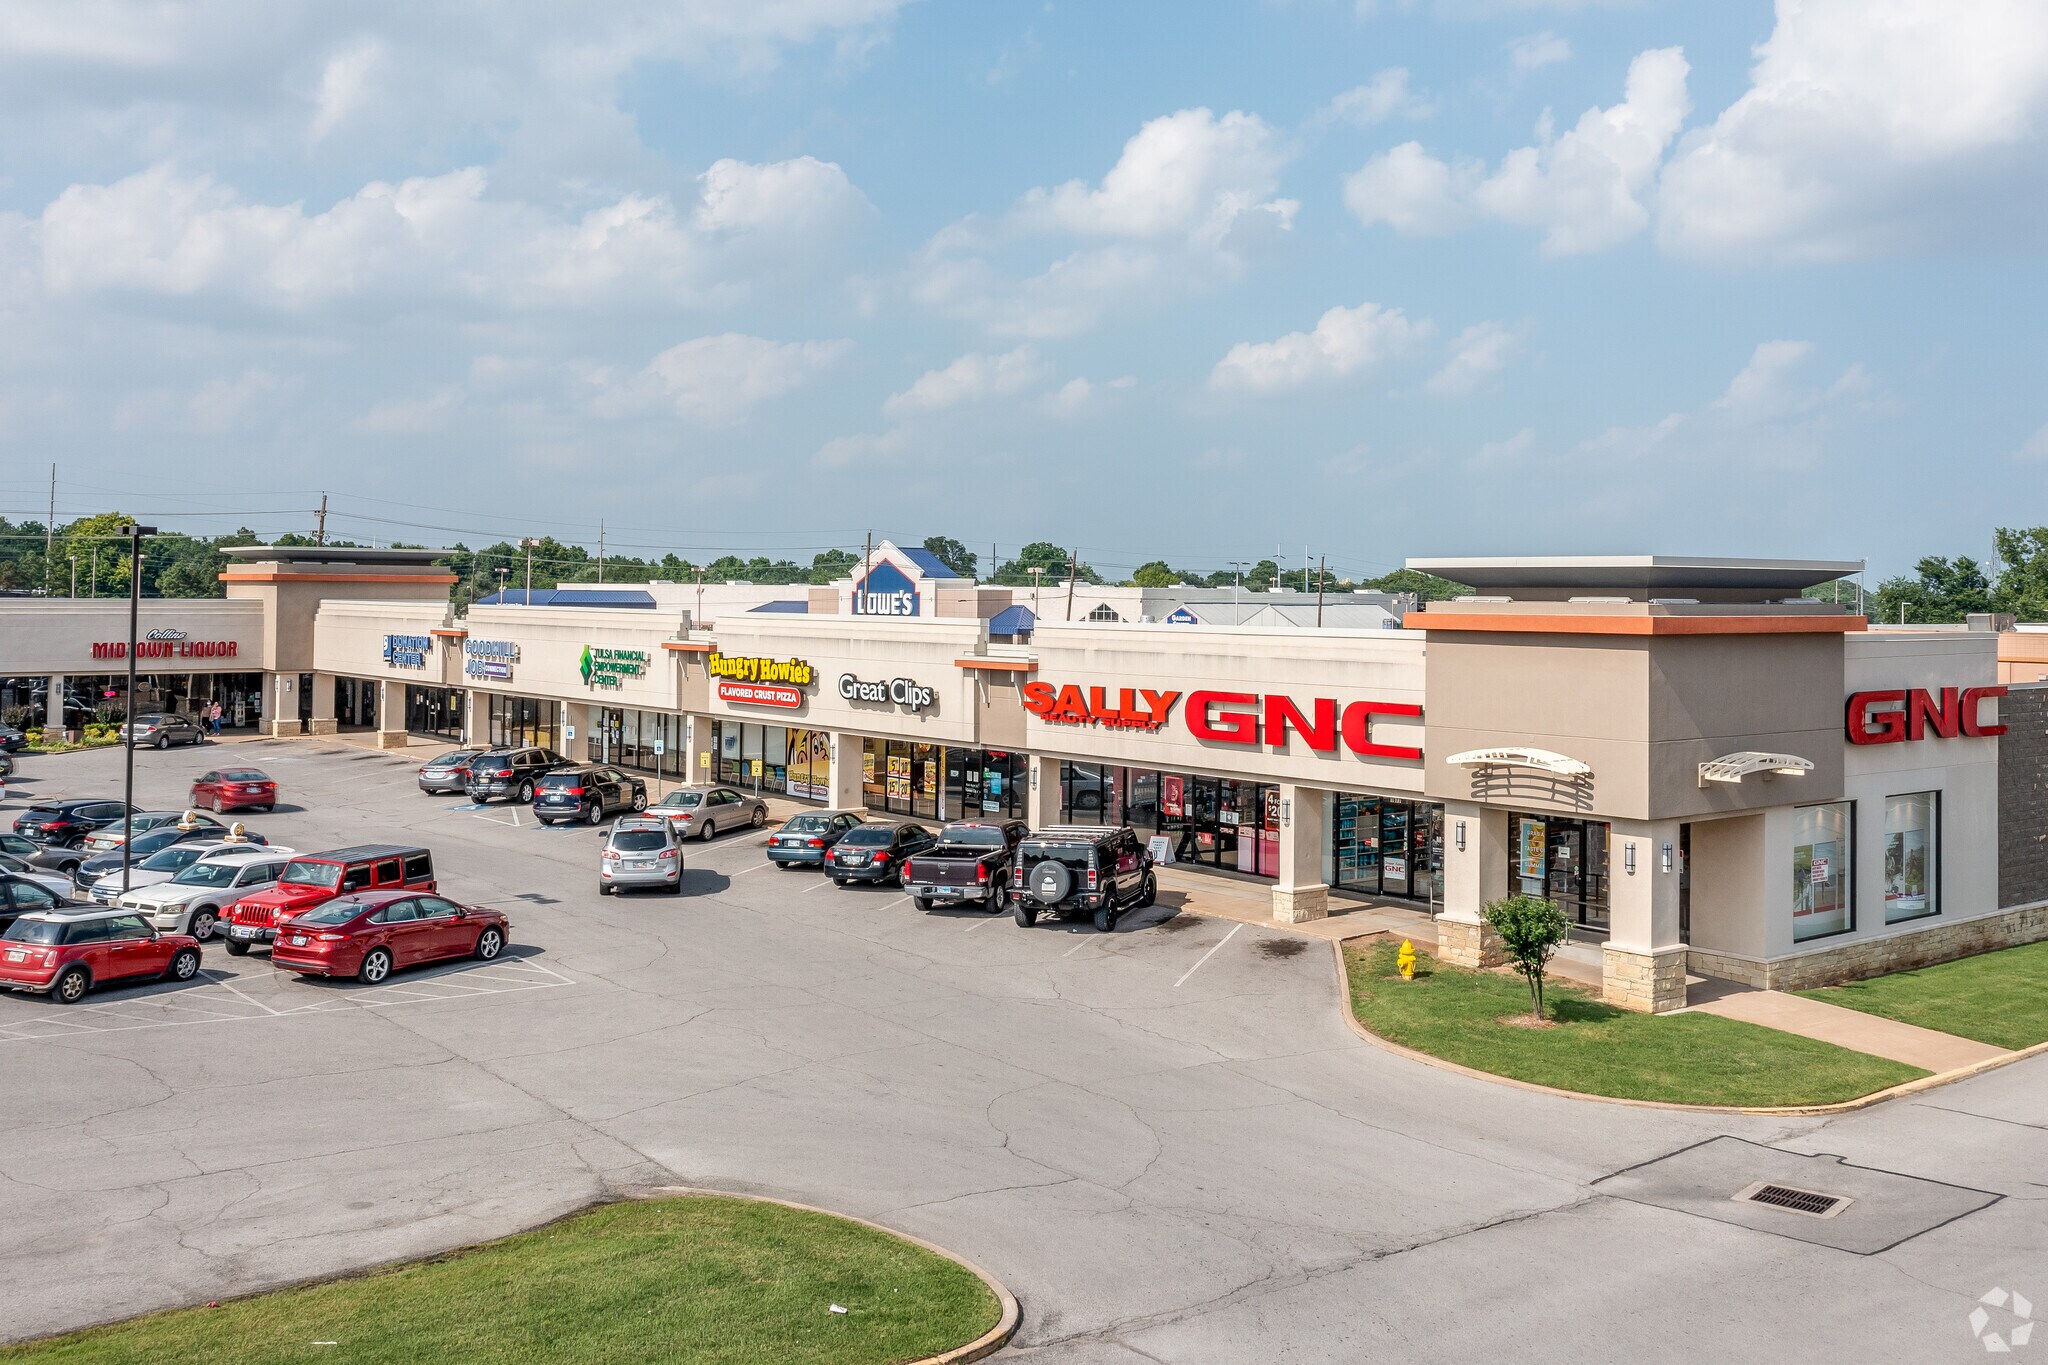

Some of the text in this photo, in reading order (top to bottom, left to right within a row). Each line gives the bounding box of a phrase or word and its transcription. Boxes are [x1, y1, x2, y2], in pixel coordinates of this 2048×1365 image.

[857, 589, 913, 616] LOWE'S
[146, 629, 188, 640] Collins
[393, 635, 430, 650] DONATION
[92, 640, 239, 659] MIDOWN LIQUOR
[465, 639, 516, 658] GOODWILL
[594, 648, 646, 662] TULSA FINANCIAL
[393, 651, 423, 665] CENTER
[465, 659, 485, 675] JOB
[594, 661, 641, 675] EMPOWERMENT
[709, 652, 811, 684] Hungry Howie's
[594, 674, 618, 686] CENTER
[720, 686, 797, 703] FLAVORED CRUST PIZZA
[839, 673, 932, 712] Great Clips
[1023, 681, 1183, 723] SALLY
[1040, 713, 1162, 730] BEAUTY SUPPLY
[1845, 686, 2009, 745] GNC
[1184, 689, 1423, 760] GNC
[1268, 794, 1274, 805] 4
[1384, 865, 1405, 873] GNC
